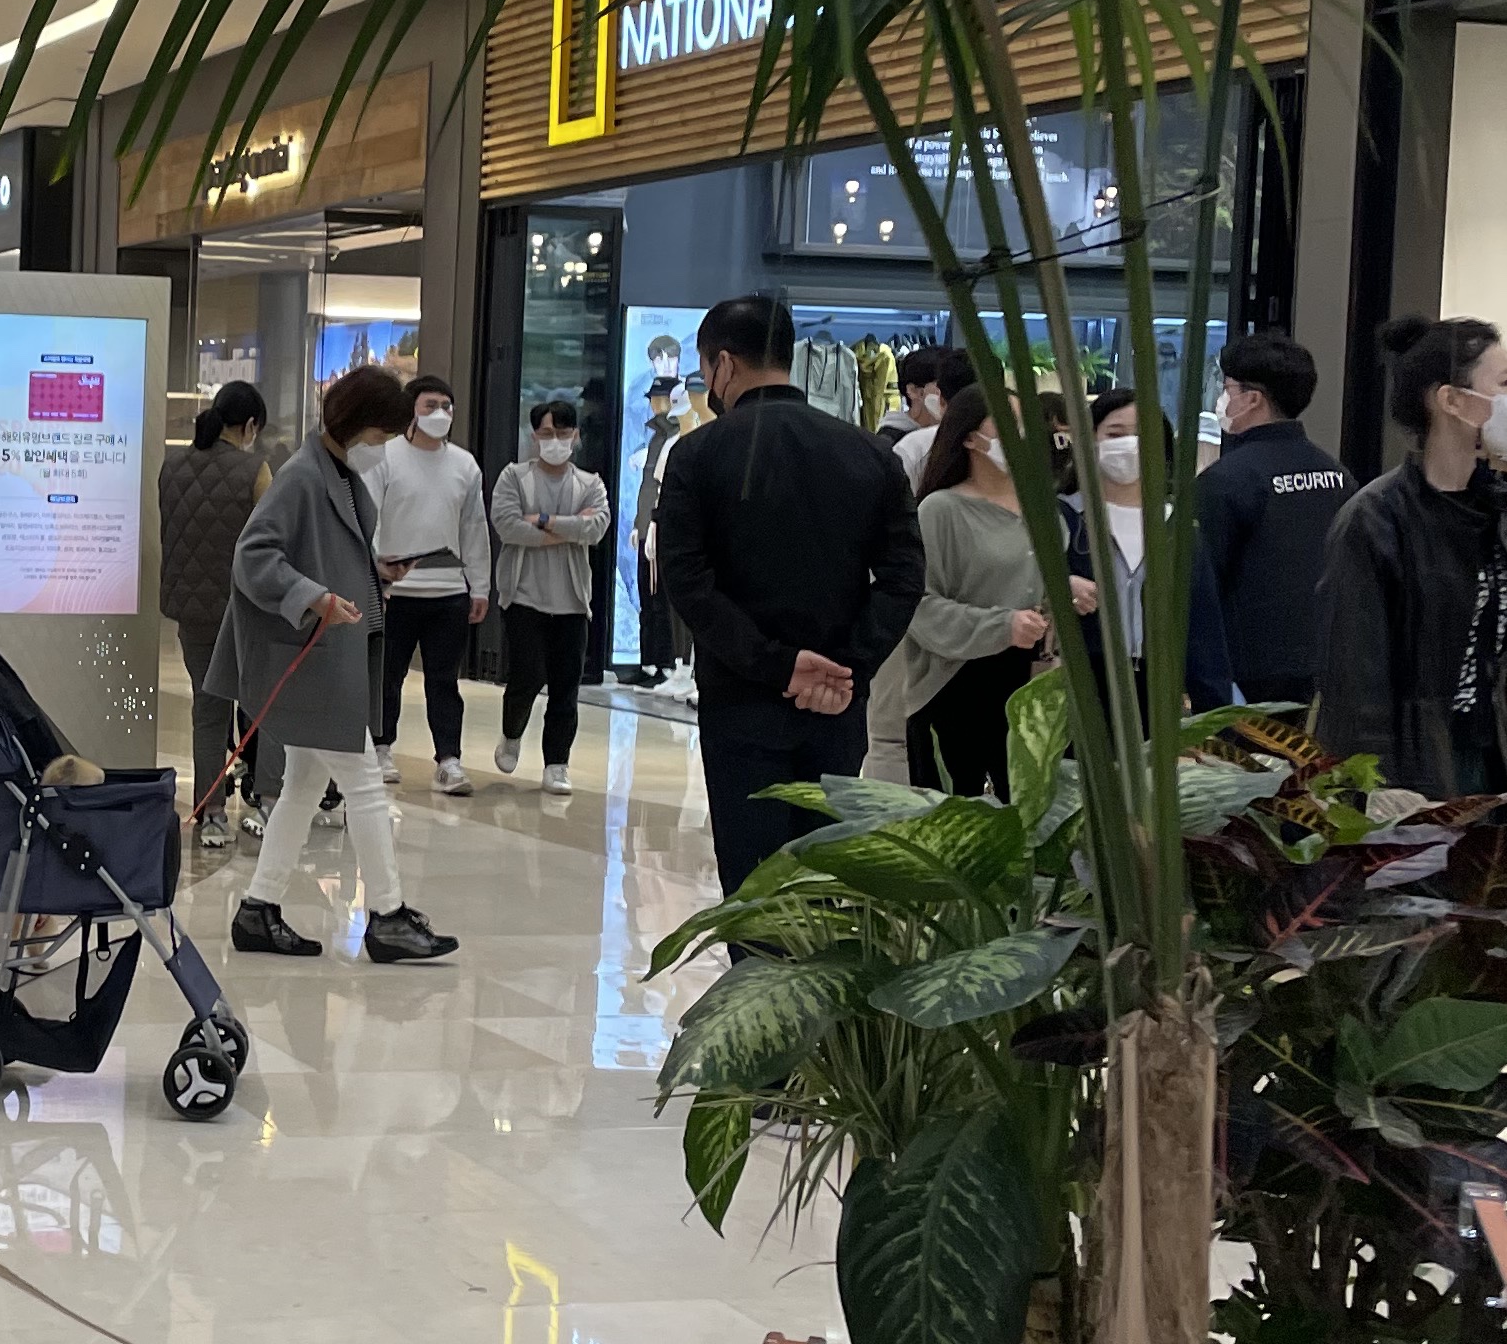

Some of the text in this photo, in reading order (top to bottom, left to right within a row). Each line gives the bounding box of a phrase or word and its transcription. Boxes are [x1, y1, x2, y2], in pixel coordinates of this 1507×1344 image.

[1, 448, 21, 462] 5%
[83, 450, 126, 464] 드립니다
[1272, 470, 1344, 494] SECURITY
